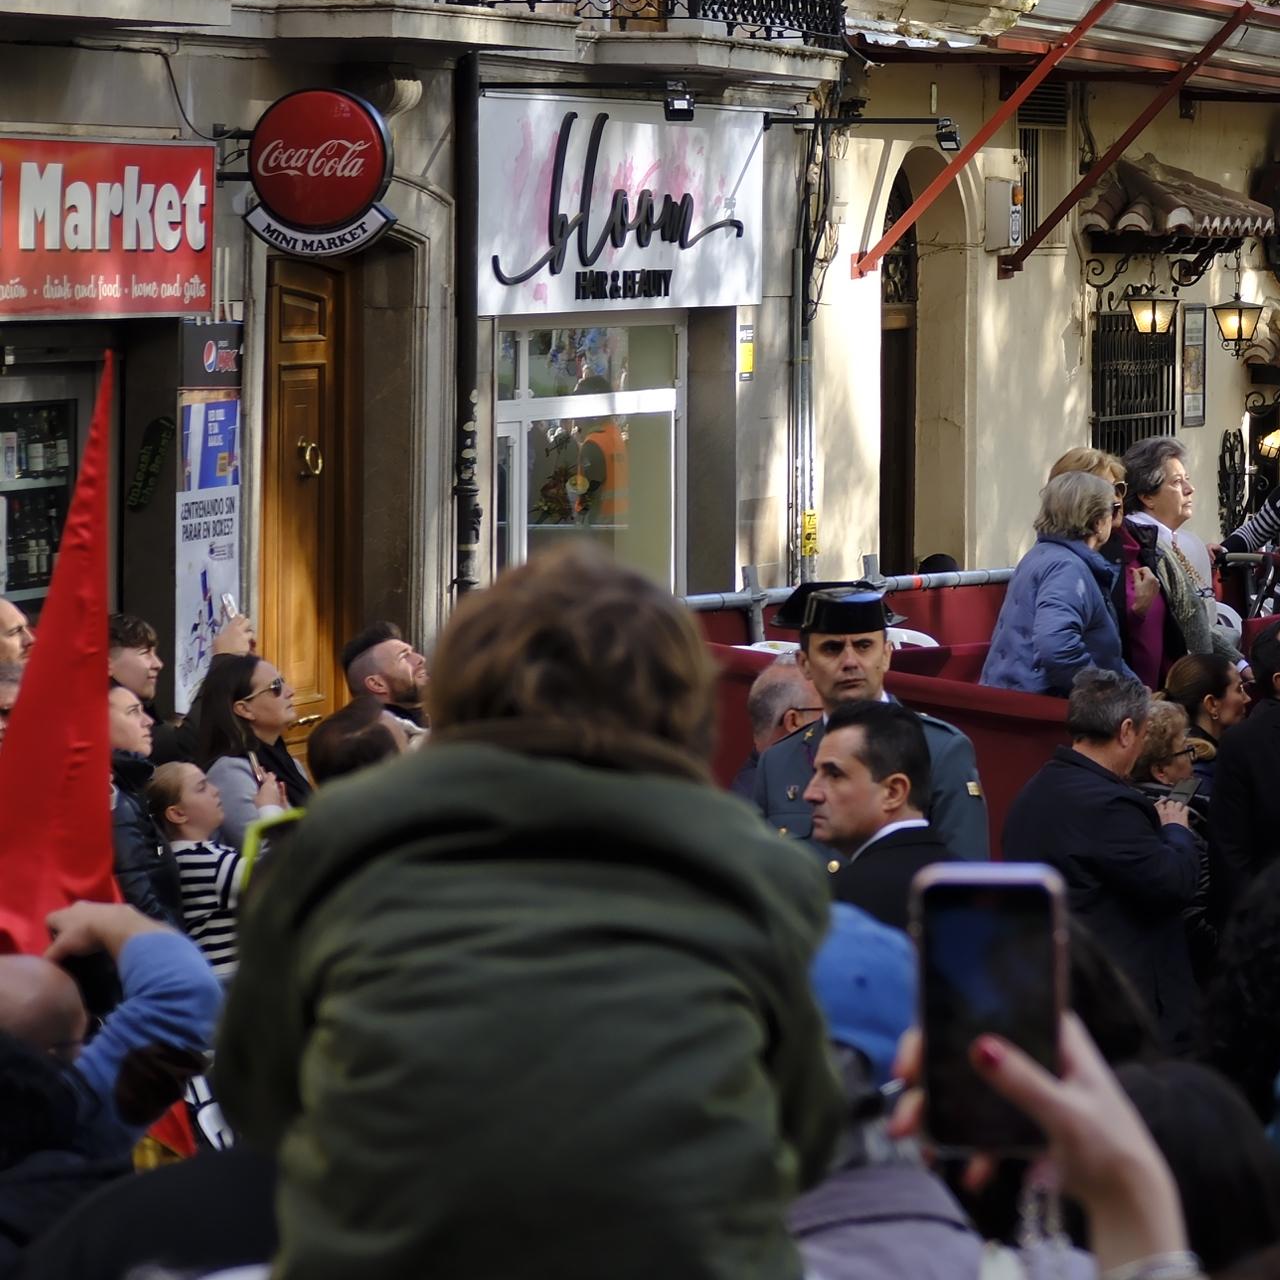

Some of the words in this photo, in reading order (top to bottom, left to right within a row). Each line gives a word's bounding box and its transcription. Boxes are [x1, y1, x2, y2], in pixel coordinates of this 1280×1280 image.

[257, 139, 372, 178] Coca-Cola
[18, 162, 207, 251] Market
[492, 111, 743, 286] bloom
[261, 223, 298, 251] MINI
[301, 222, 369, 252] MARKET
[43, 274, 74, 301] drink
[75, 275, 97, 300] and
[98, 274, 121, 300] food
[575, 271, 608, 300] HAIR
[610, 271, 622, 299] &
[623, 269, 673, 298] BEAUTY
